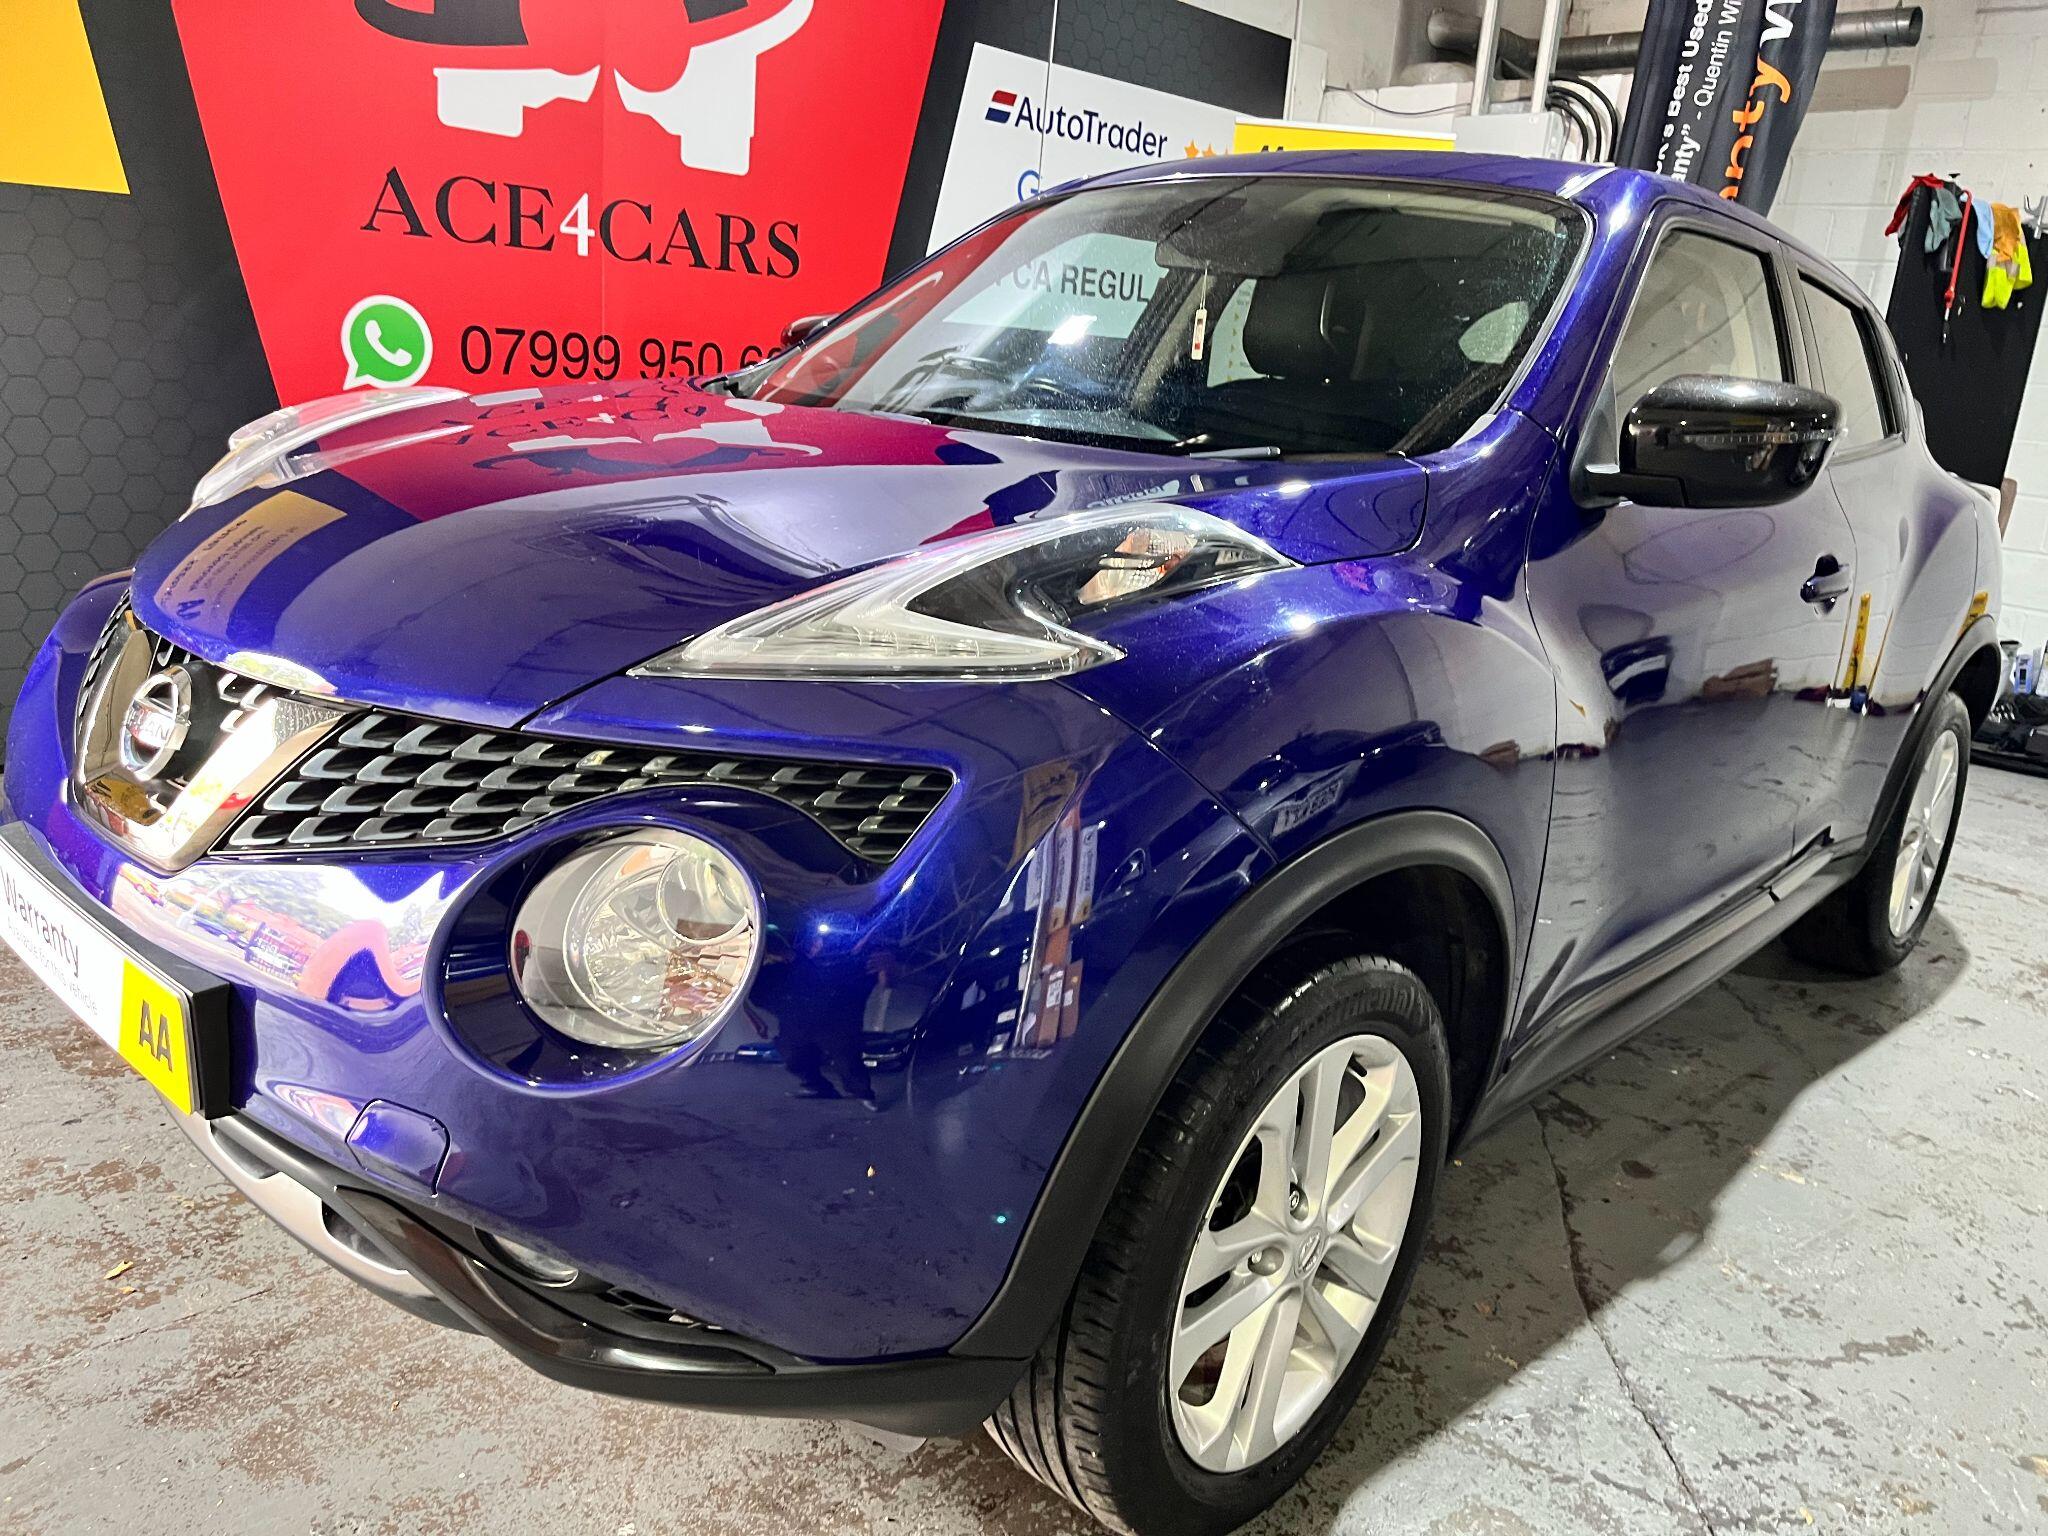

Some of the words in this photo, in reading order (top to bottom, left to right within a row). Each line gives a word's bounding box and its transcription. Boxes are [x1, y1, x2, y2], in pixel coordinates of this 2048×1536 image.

[1667, 63, 1694, 117] Best
[1682, 0, 1713, 58] Used
[1694, 30, 1733, 107] Quentin
[1015, 97, 1168, 158] AutoTrader
[361, 166, 800, 279] ACE4CARS
[1060, 264, 1149, 303] REGUL
[460, 325, 621, 380] 07999
[639, 338, 723, 380] 950
[0, 866, 79, 979] Warranty
[138, 999, 173, 1072] AA
